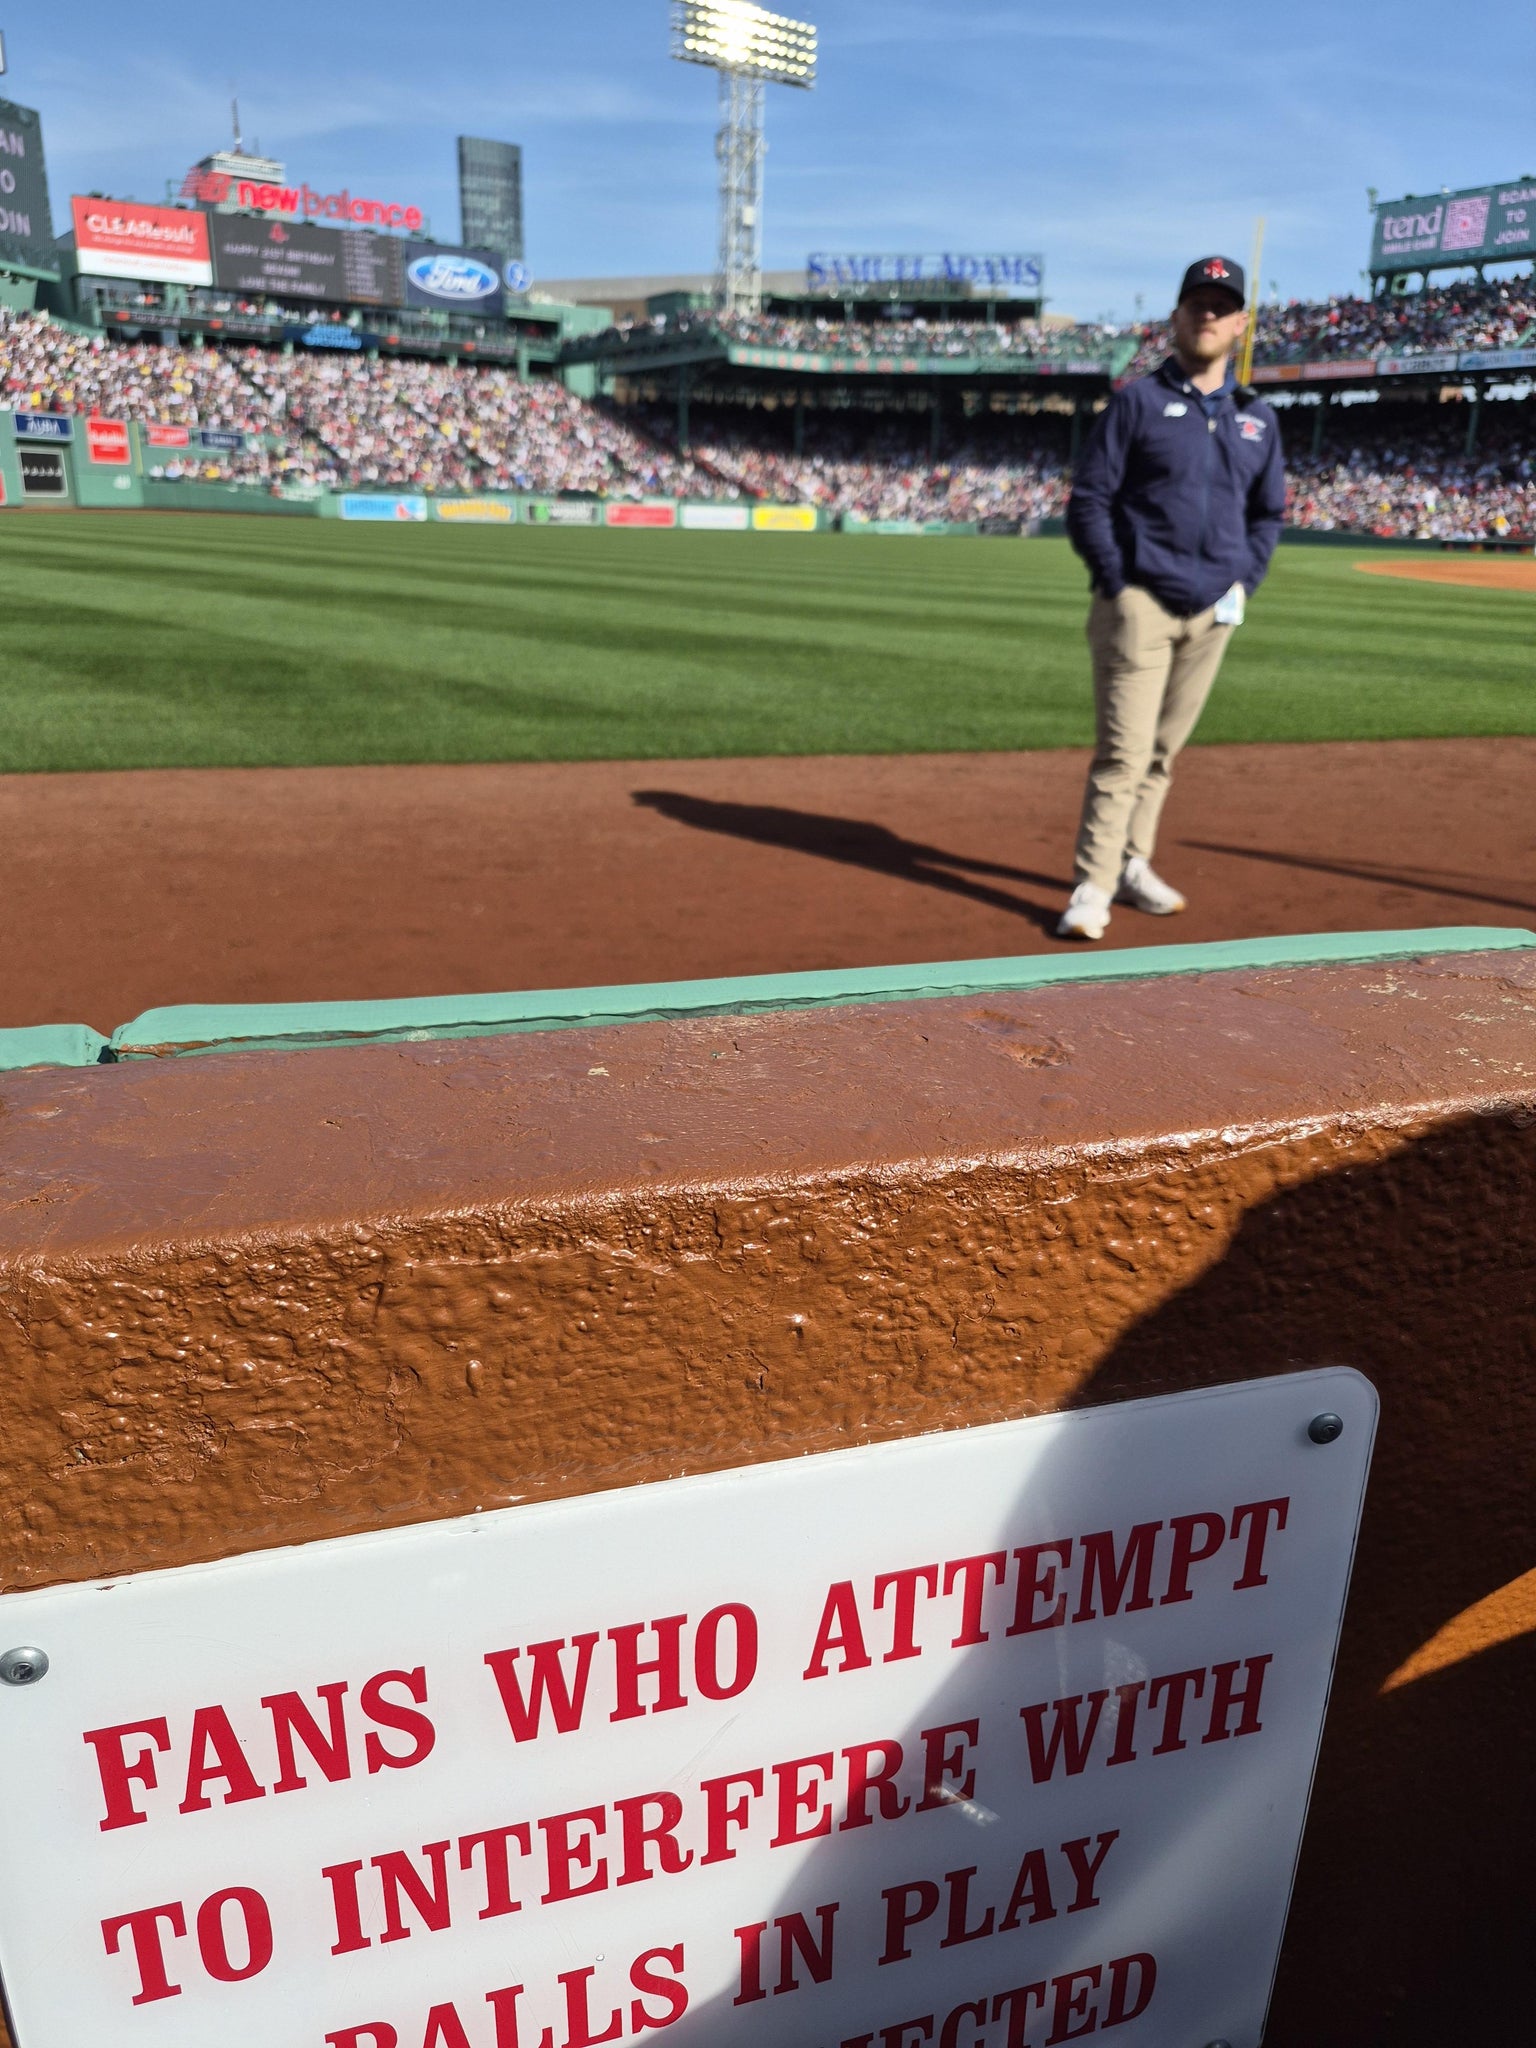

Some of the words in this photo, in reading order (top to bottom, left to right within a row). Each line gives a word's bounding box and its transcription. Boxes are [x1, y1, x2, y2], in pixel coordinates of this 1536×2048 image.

[238, 181, 299, 213] new
[303, 182, 422, 231] balance
[1383, 205, 1443, 241] tend
[1506, 208, 1527, 224] TO
[87, 213, 195, 245] CLEAResult
[1494, 229, 1530, 245] JOIN
[424, 260, 482, 293] Ford
[807, 252, 925, 288] SAMUEL
[941, 252, 1042, 286] ADAMS
[83, 1667, 435, 1831] FANS
[484, 1603, 758, 1742] WHO
[803, 1496, 1290, 1680] ATTEMPT
[101, 1887, 273, 2005] TO
[322, 1718, 979, 1955] INTERFERE
[1019, 1654, 1273, 1784] WITH
[734, 1902, 839, 2006] IN
[877, 1829, 1120, 1966] PLAY
[828, 1952, 1157, 2048] CTED
